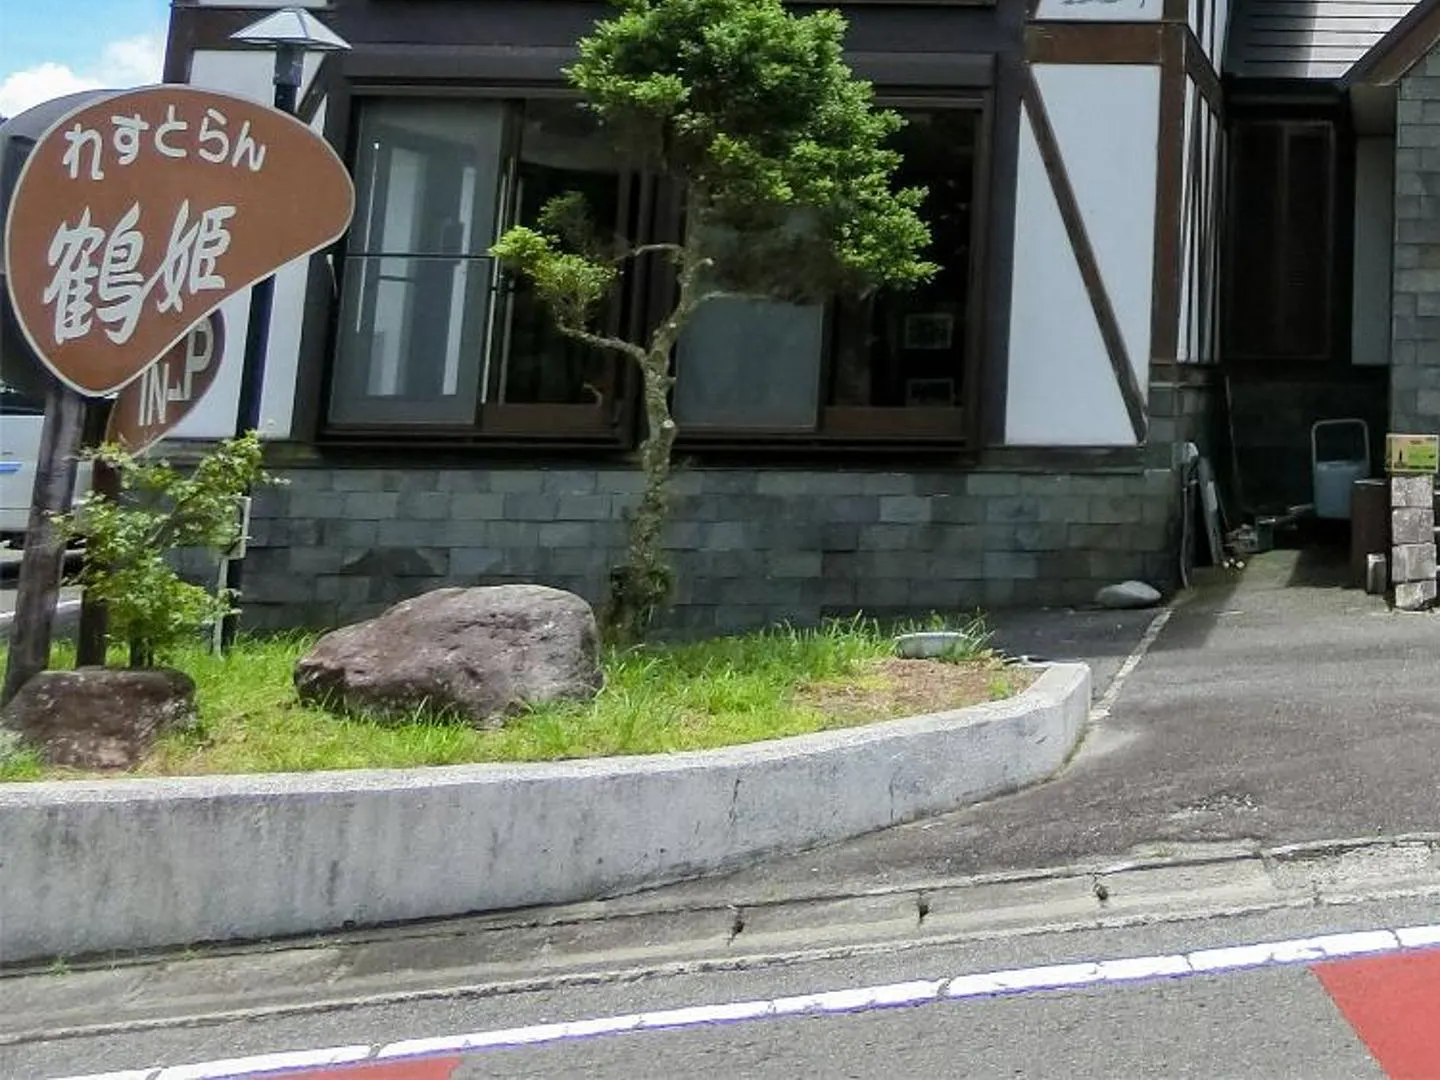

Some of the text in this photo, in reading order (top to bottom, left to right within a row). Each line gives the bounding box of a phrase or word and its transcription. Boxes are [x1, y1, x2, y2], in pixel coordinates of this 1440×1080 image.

[62, 105, 266, 181] れすとらん
[43, 200, 237, 345] 鶴姫
